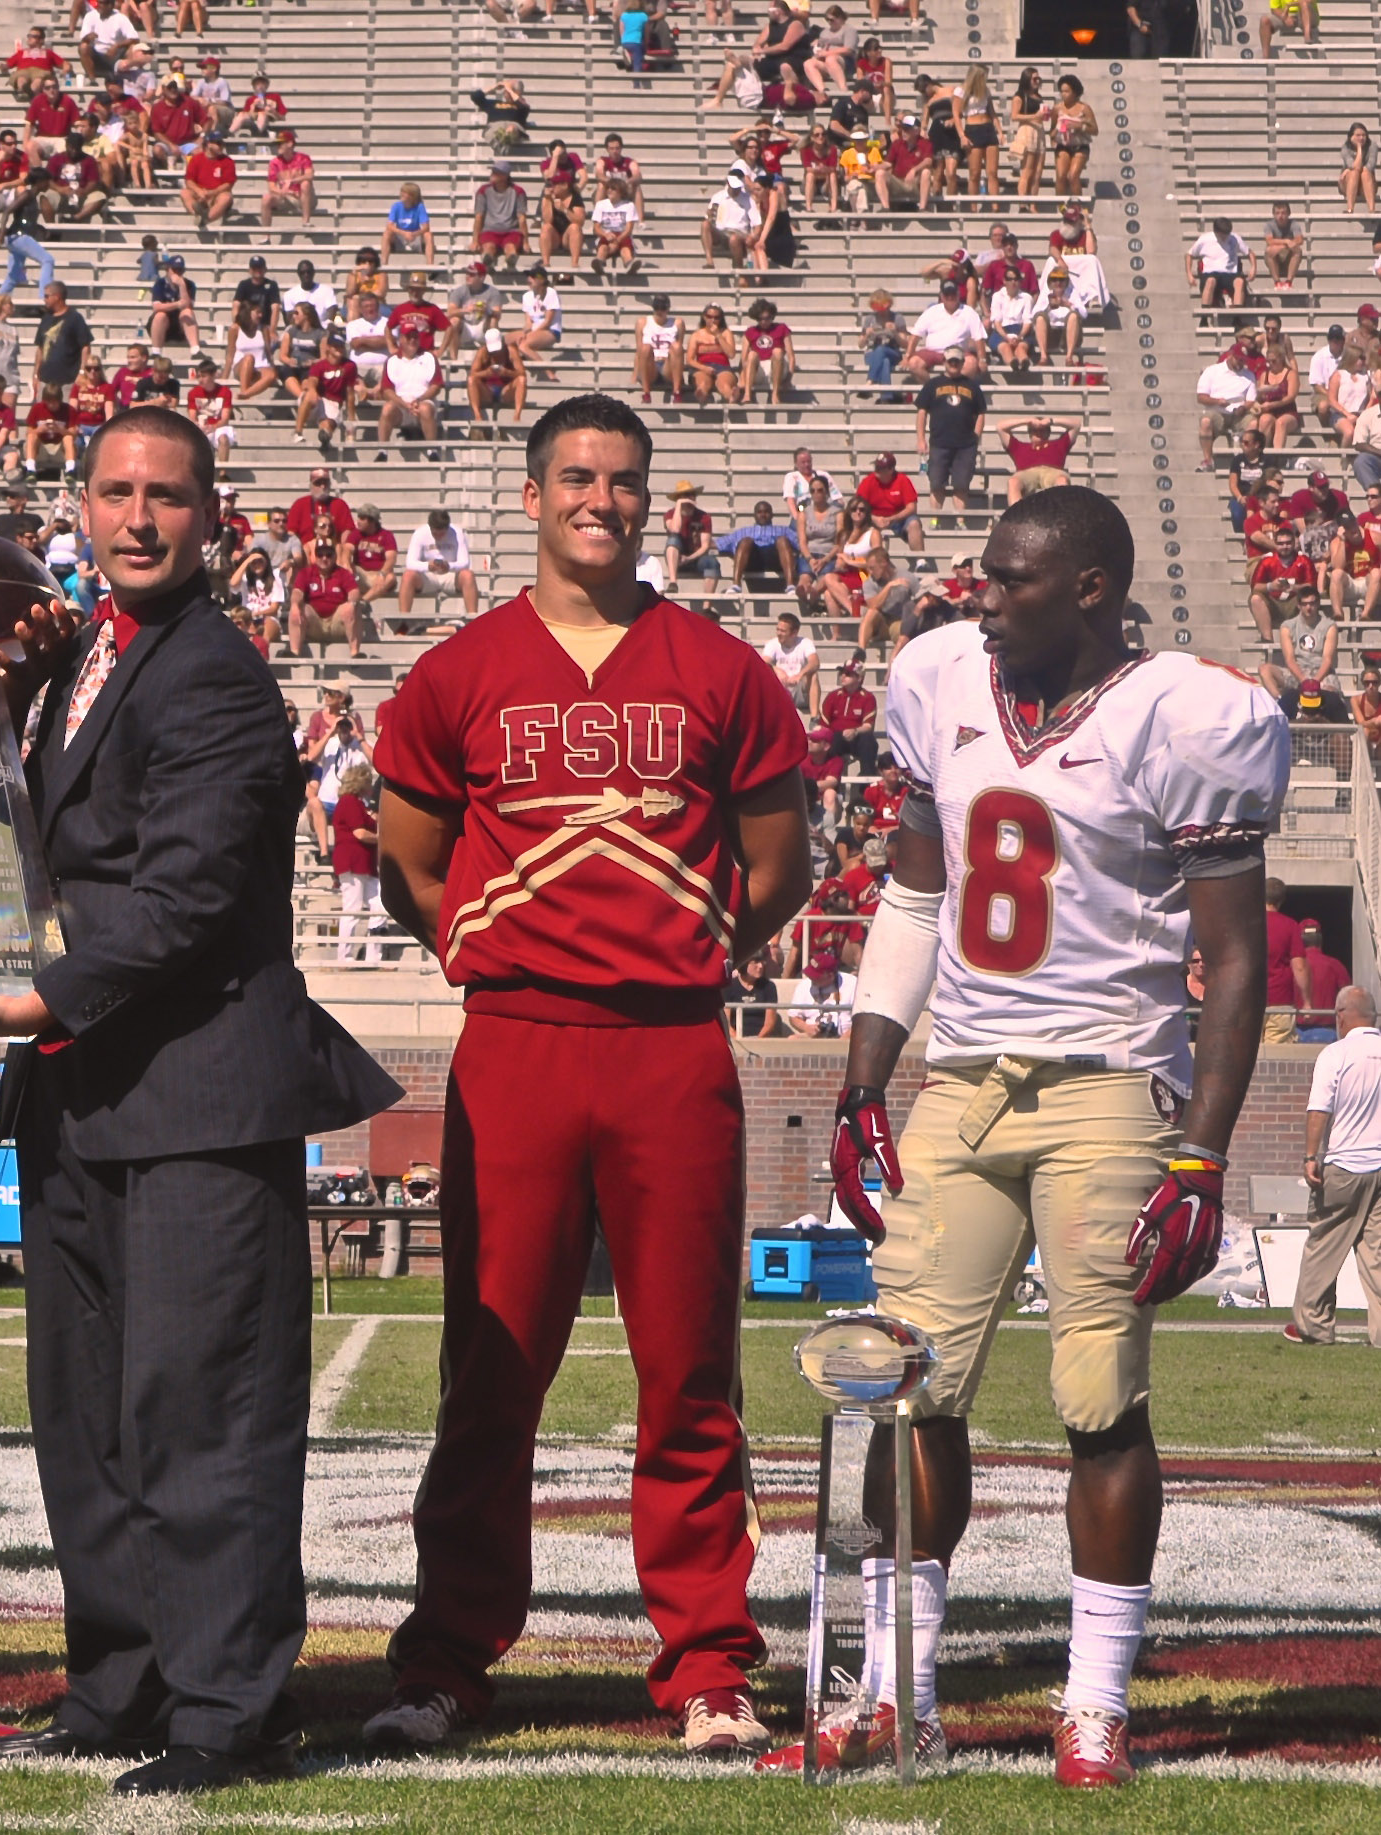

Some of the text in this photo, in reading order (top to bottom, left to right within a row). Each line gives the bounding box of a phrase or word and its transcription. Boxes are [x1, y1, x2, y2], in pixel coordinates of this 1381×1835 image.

[500, 702, 685, 784] FSU
[957, 786, 1061, 978] 8
[6, 960, 32, 970] STATE
[836, 1639, 866, 1649] TROPH
